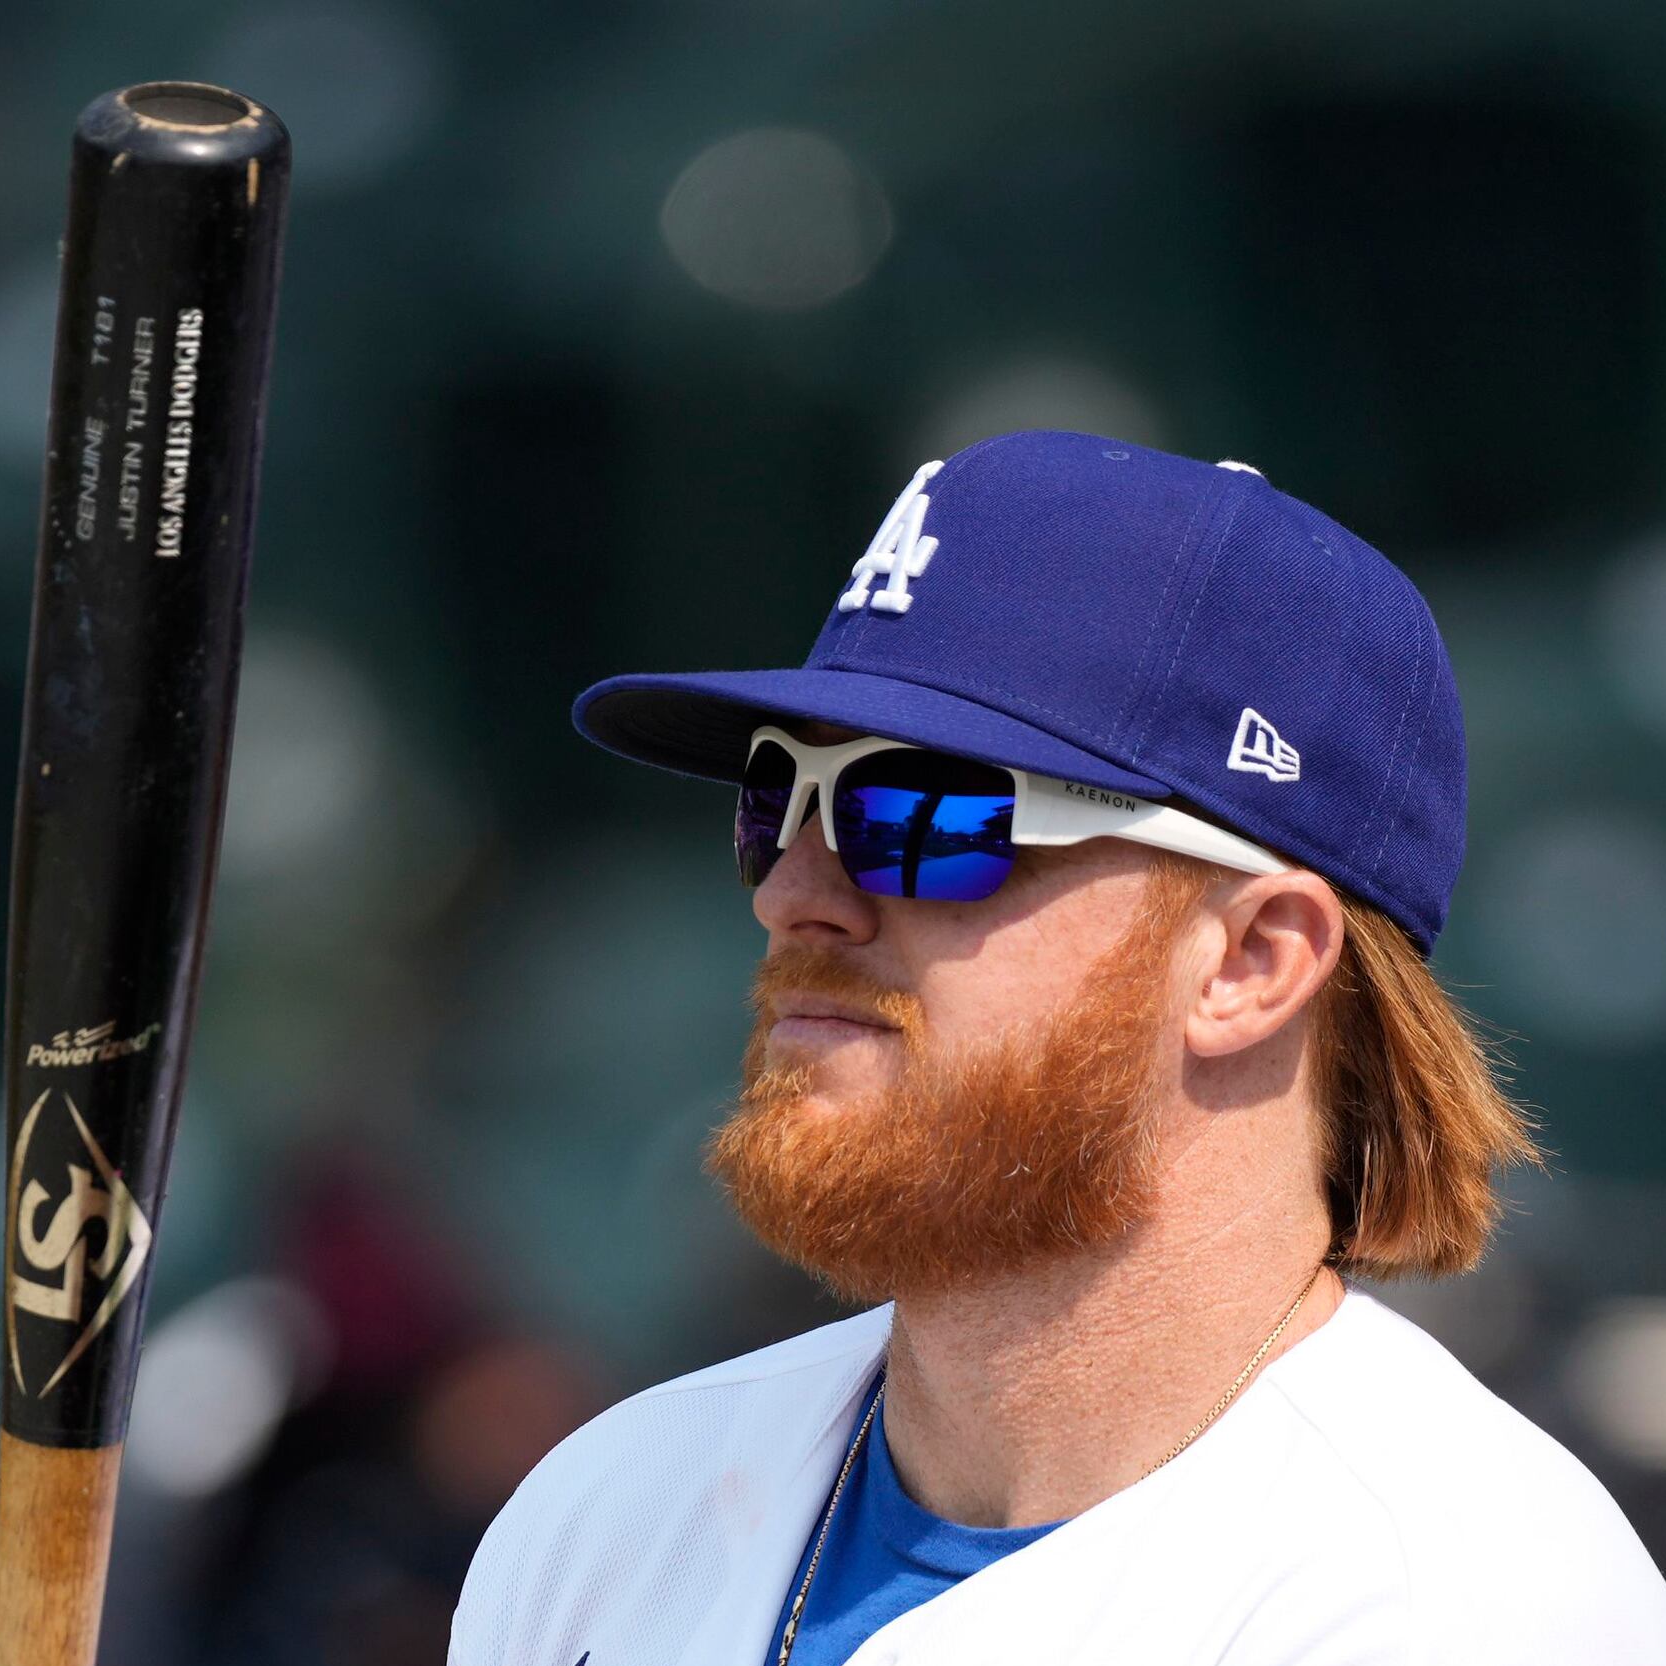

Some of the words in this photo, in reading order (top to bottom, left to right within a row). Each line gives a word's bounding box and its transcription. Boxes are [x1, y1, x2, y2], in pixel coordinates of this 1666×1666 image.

[126, 317, 156, 431] TURNER
[168, 308, 205, 418] DODGERS
[75, 416, 105, 541] GENUINE
[118, 443, 144, 541] JUSTIN
[161, 420, 194, 515] ANGELES
[154, 515, 183, 557] LOS
[838, 460, 945, 614] LA
[1065, 782, 1136, 812] KAENON
